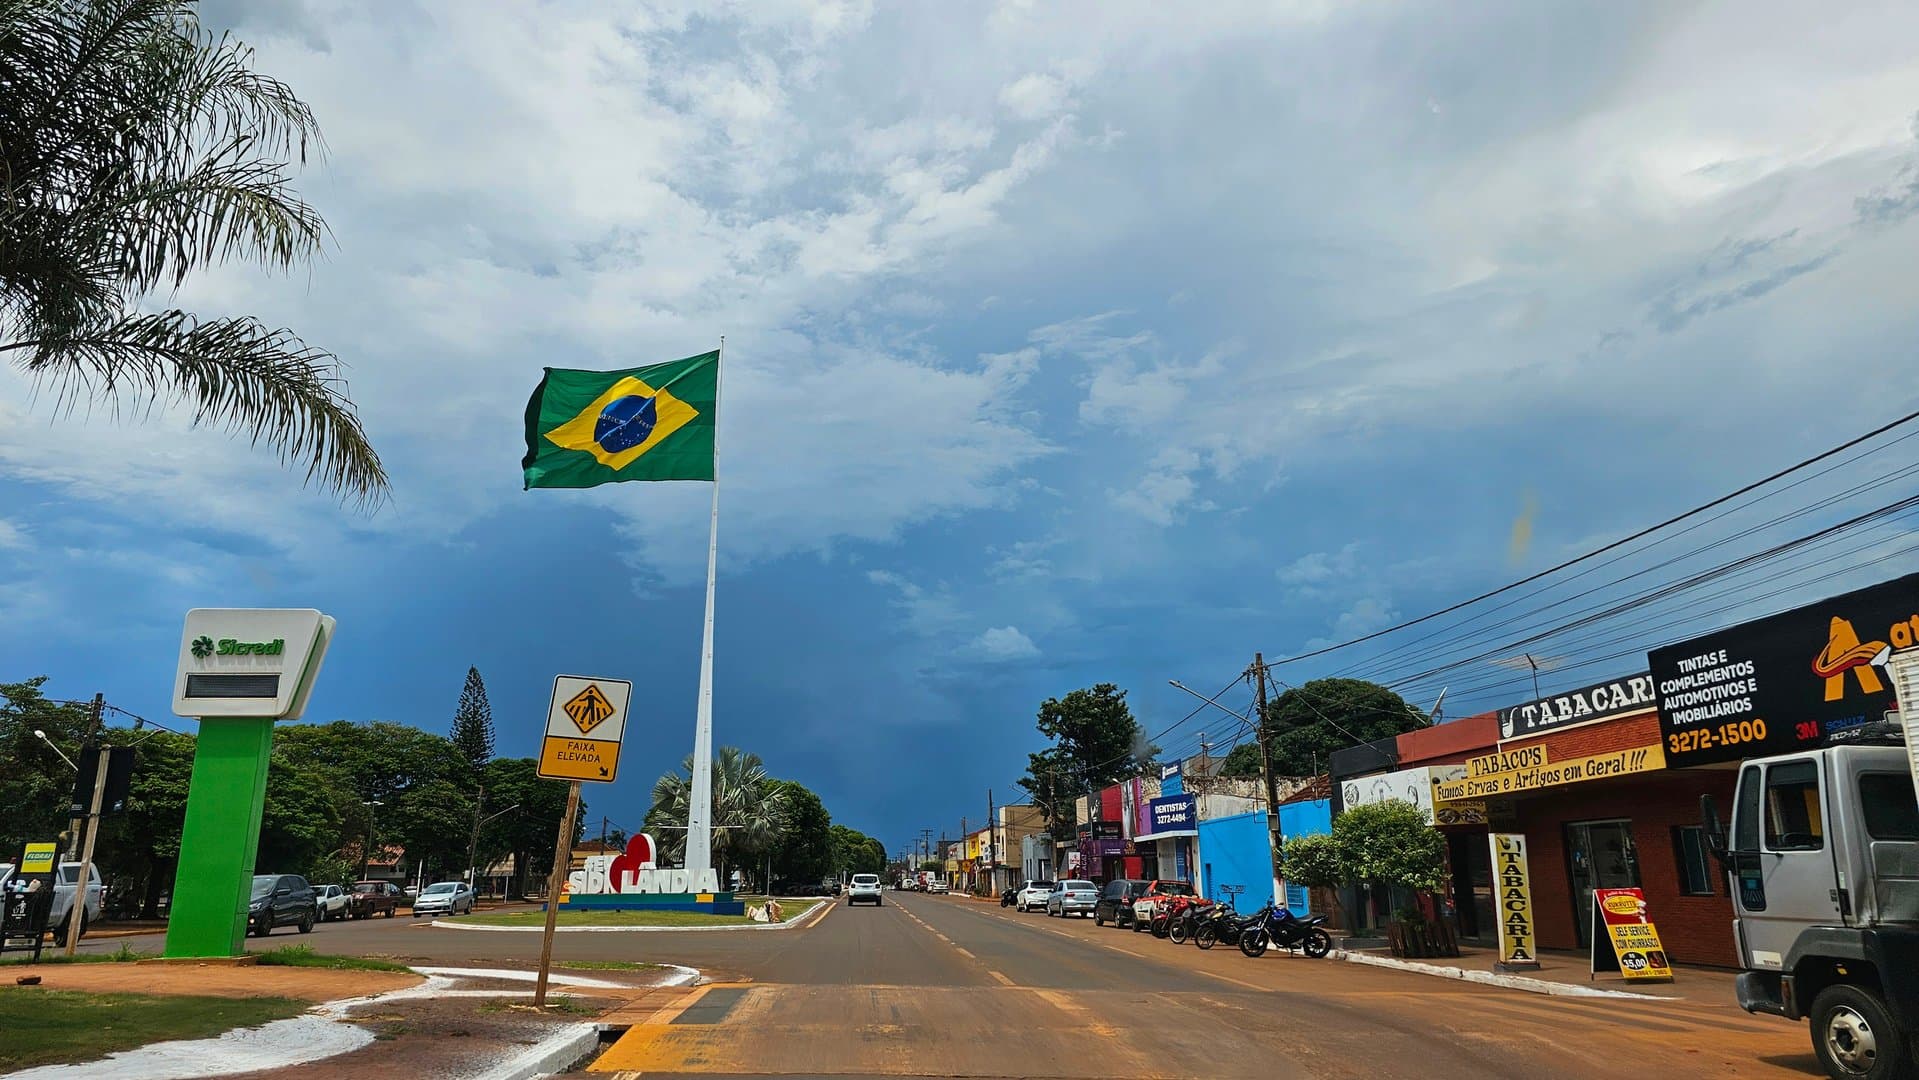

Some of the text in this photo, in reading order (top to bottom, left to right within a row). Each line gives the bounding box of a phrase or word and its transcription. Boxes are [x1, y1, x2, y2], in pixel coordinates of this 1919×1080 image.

[216, 639, 285, 655] Sicredi
[1677, 649, 1728, 673] TINTAS E
[1660, 660, 1755, 694] COMPLEMENTOS
[1664, 678, 1758, 710] AUTOMOTIVOS E
[1672, 697, 1753, 725] IMOBILIÁRIOS
[1668, 719, 1767, 753] 3272-1500
[1795, 720, 1819, 740] 3M
[557, 751, 600, 763] ELEVADA
[567, 742, 595, 752] FAIXA
[1467, 778, 1499, 796] Ervas
[1503, 778, 1510, 790] e
[1514, 769, 1561, 788] Artigos
[1563, 769, 1582, 782] em
[1586, 753, 1626, 777] Geral
[1472, 747, 1542, 776] TABACO'S
[1154, 802, 1187, 814] DENTISTAS
[1501, 852, 1532, 960] TABACARIA
[1623, 958, 1646, 969] 35,00
